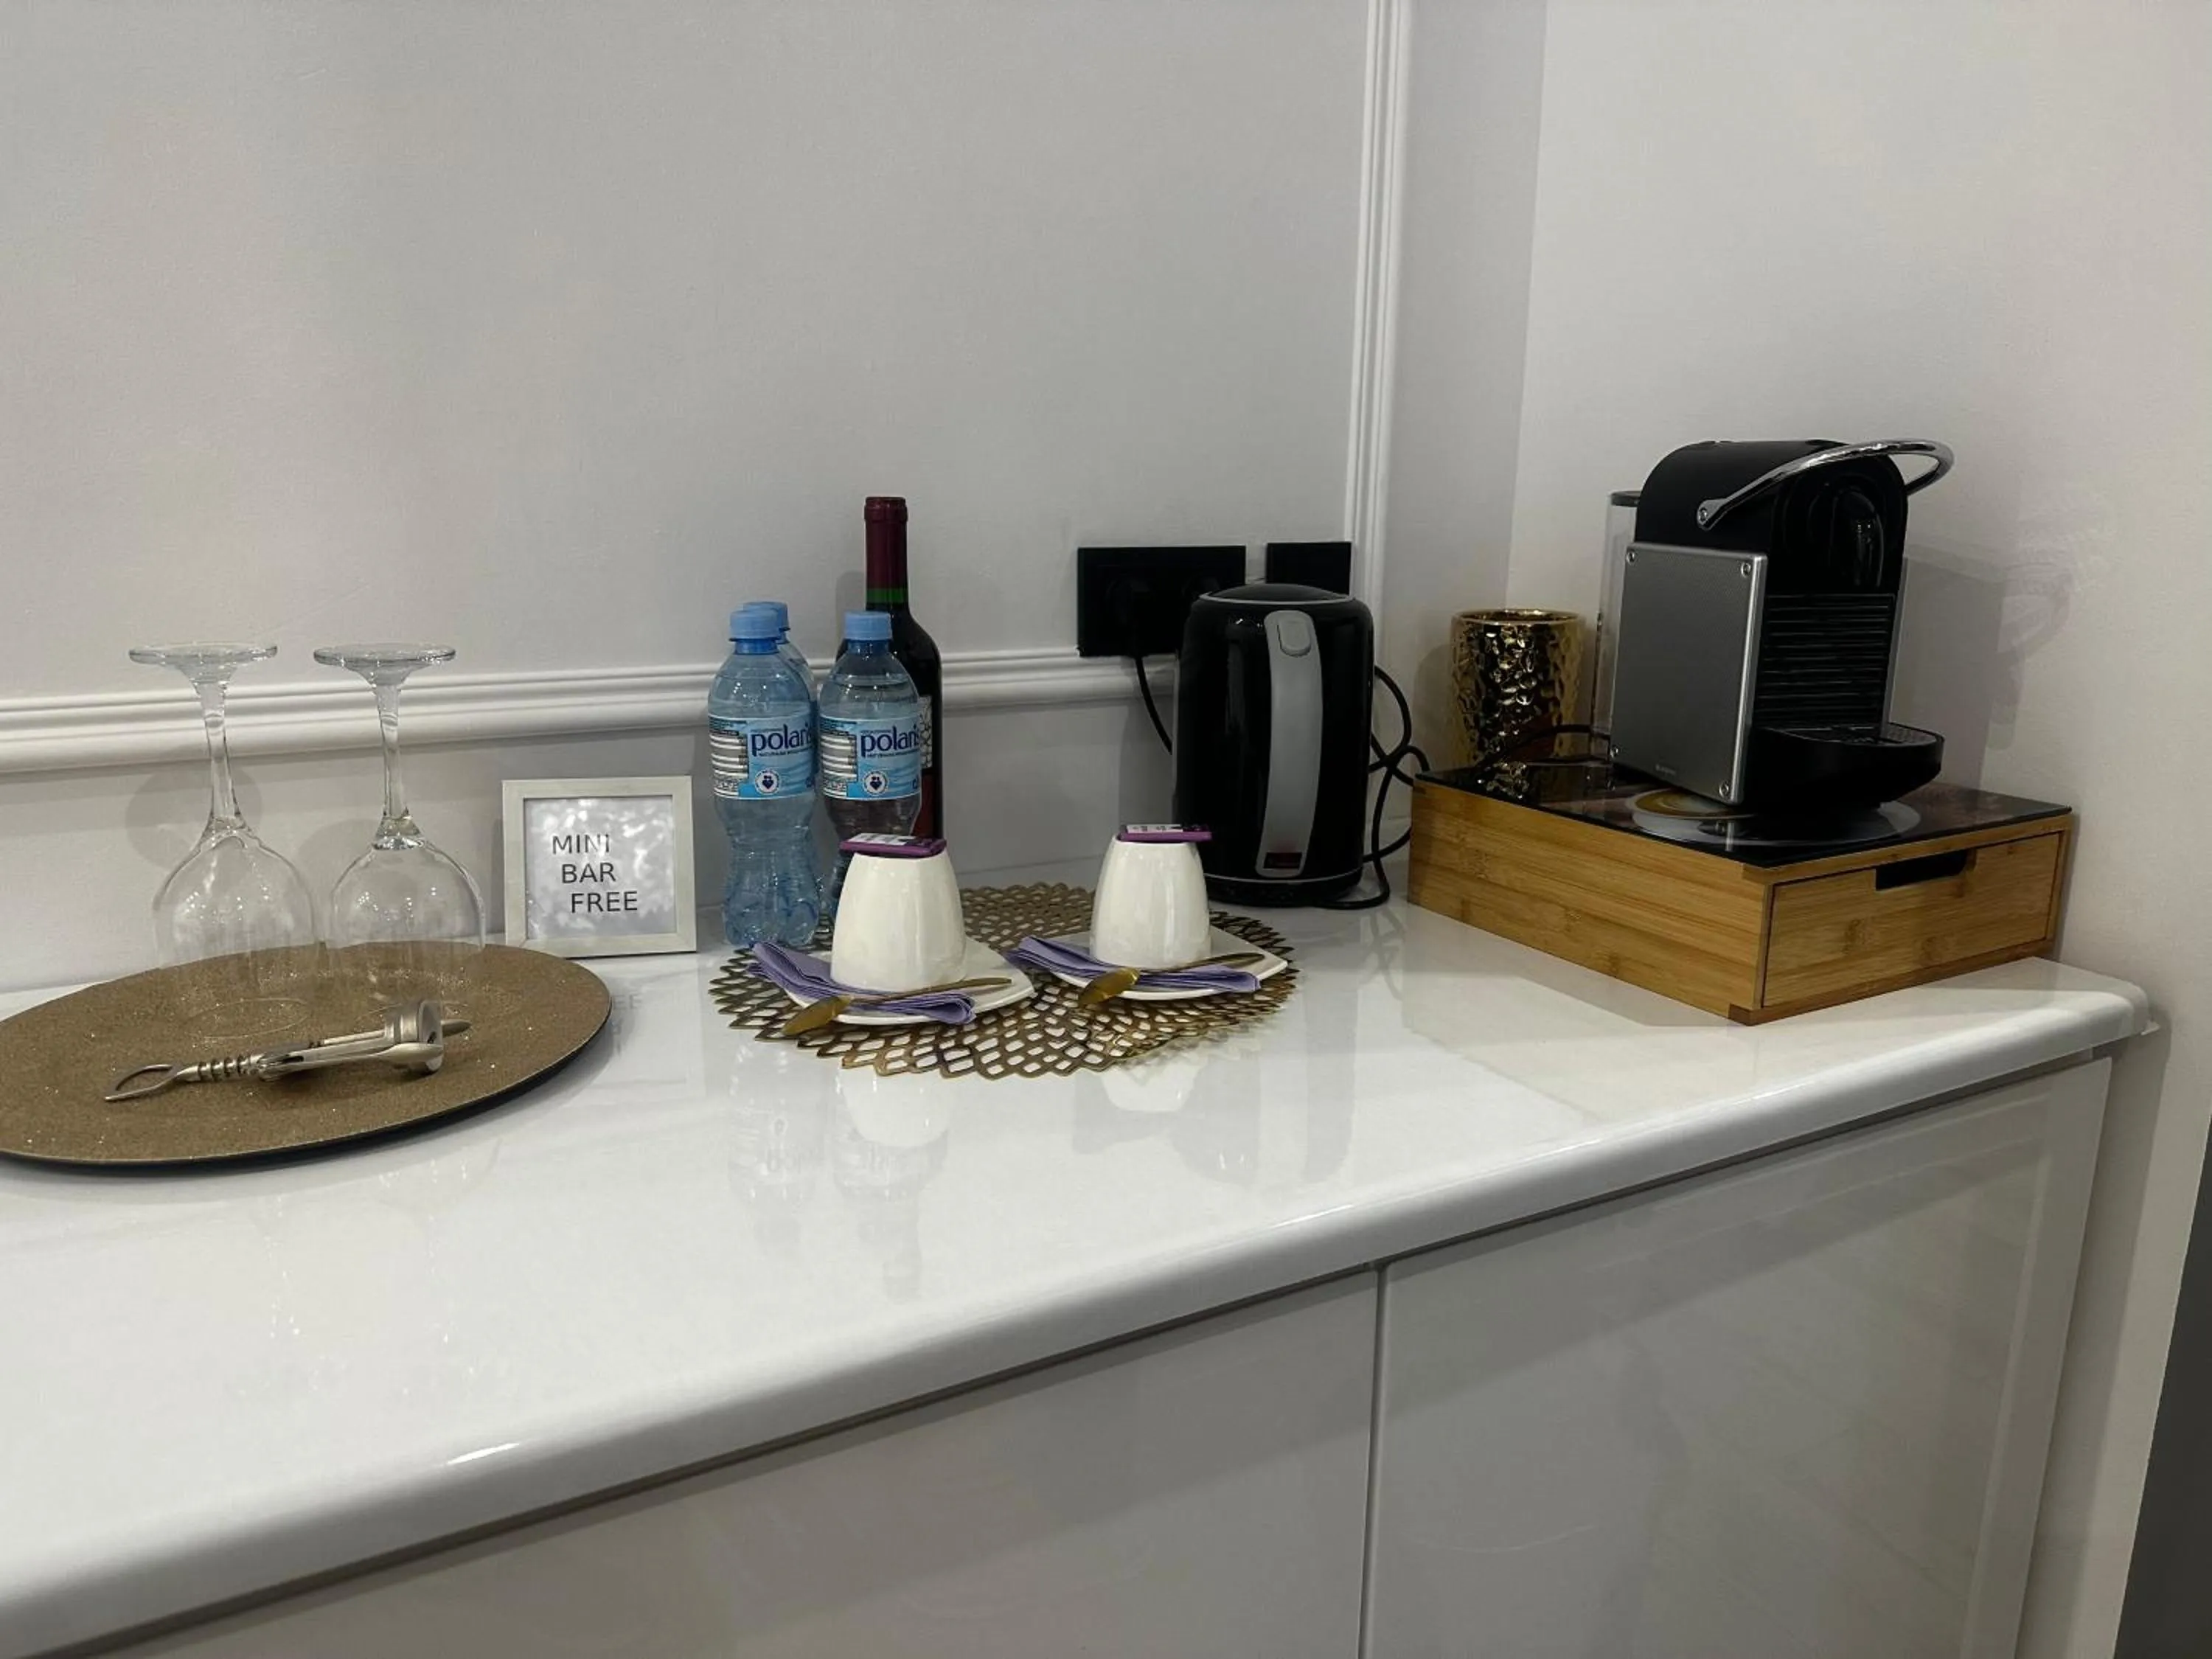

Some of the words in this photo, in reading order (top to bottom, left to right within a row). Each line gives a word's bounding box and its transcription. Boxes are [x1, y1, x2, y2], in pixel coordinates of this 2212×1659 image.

[751, 723, 811, 757] polari
[552, 834, 610, 854] MINI
[561, 862, 616, 884] BAR
[571, 890, 638, 914] FREE
